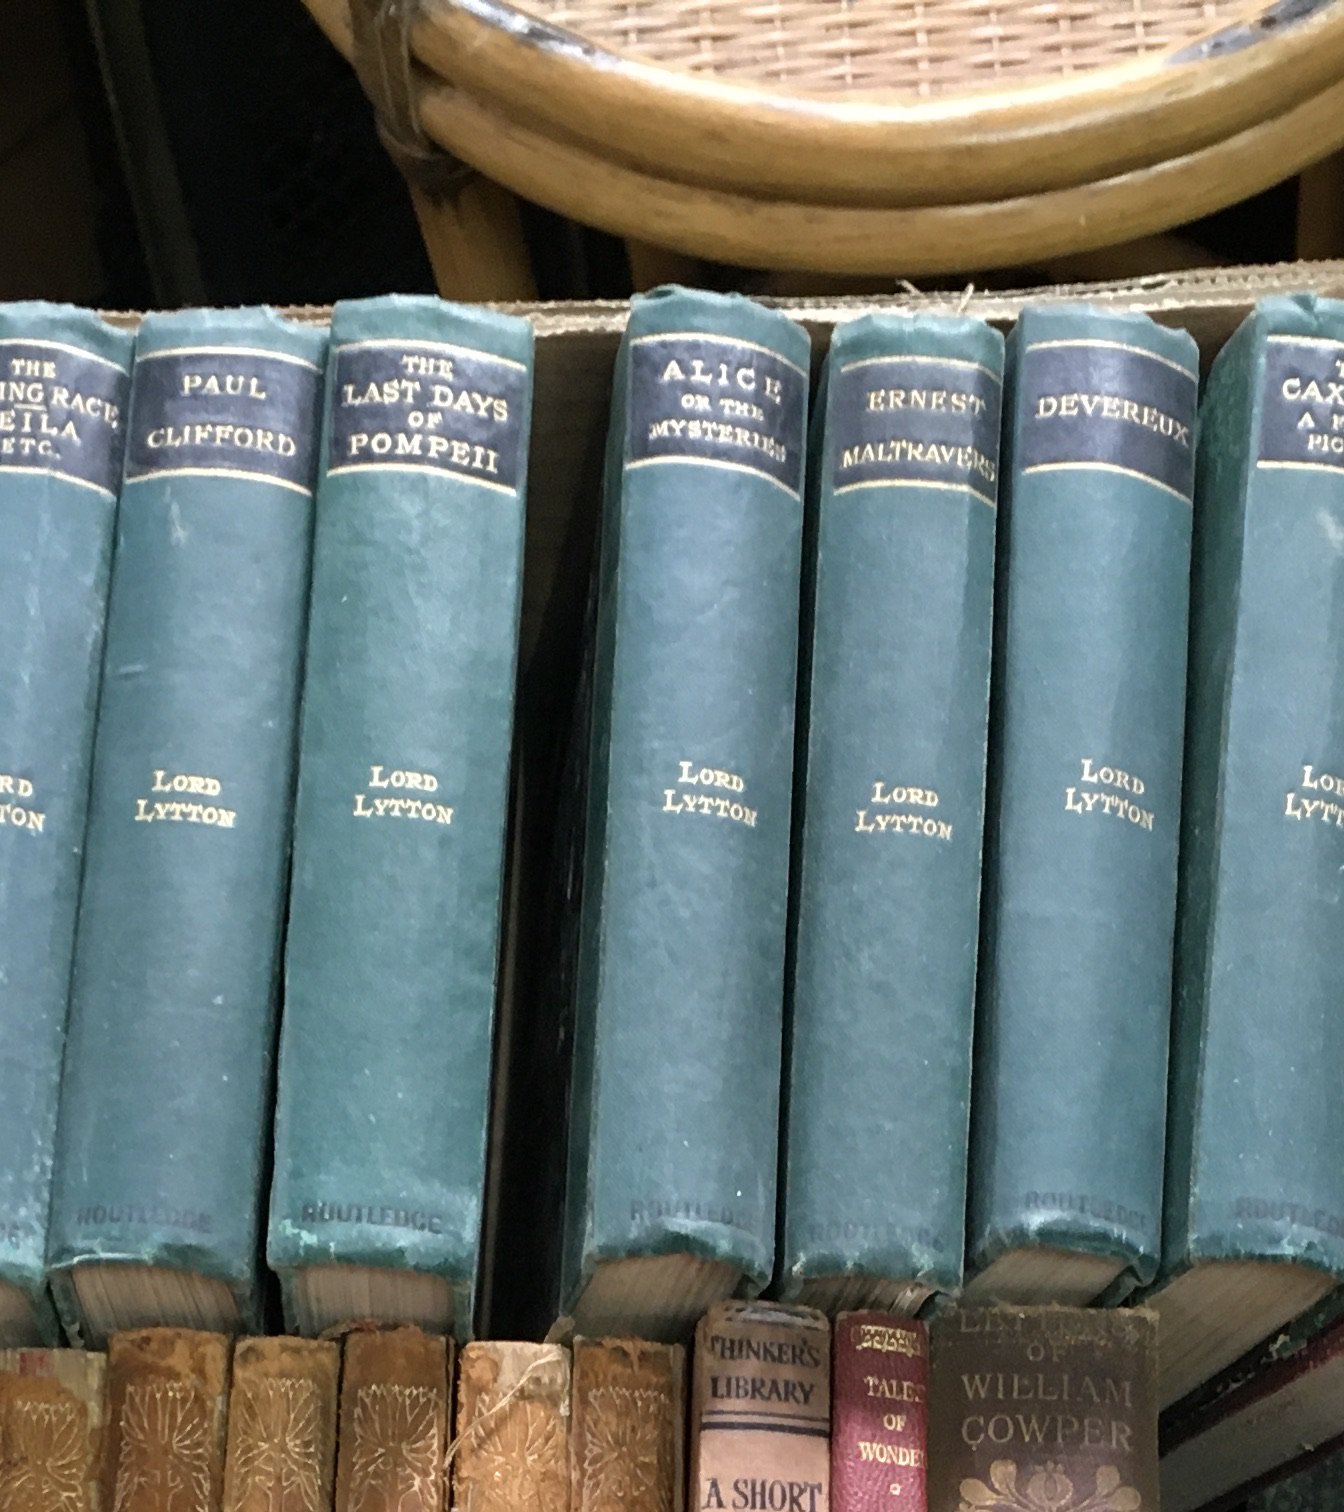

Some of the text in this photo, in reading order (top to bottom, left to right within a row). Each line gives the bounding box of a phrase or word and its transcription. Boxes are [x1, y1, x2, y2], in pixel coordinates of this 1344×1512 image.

[10, 357, 58, 380] THE
[401, 354, 456, 383] THE
[659, 358, 784, 406] ALICE
[181, 373, 268, 402] PAUL
[342, 379, 511, 422] LAST DAYS
[865, 387, 988, 417] ERNEST
[407, 410, 444, 430] OF
[680, 391, 766, 422] OR THE
[1034, 393, 1191, 448] DEVEREUX
[1296, 409, 1317, 430] A
[145, 423, 297, 457] CLIFFORD
[347, 431, 501, 475] POMPEII
[648, 418, 788, 463] MYSTERIES
[839, 437, 998, 484] MALTRAVERS
[151, 769, 222, 797] LORD
[368, 764, 440, 793] LORD
[677, 760, 746, 794] LORD
[1080, 757, 1146, 796] LORD
[353, 794, 455, 825] LYTTON
[661, 788, 758, 829] LYTTON
[871, 780, 940, 809] LORD
[1064, 786, 1155, 833] LYTTON
[133, 798, 238, 829] LYTTON
[854, 809, 954, 842] LYTTON
[299, 1200, 444, 1235] ROUTLEDGE
[710, 1334, 821, 1368] THINKER'S
[710, 1375, 816, 1404] LIBRARY
[960, 1373, 1134, 1408] WILLIAM
[883, 1413, 907, 1432] OF
[960, 1413, 1134, 1451] COWPER
[702, 1477, 727, 1511] A
